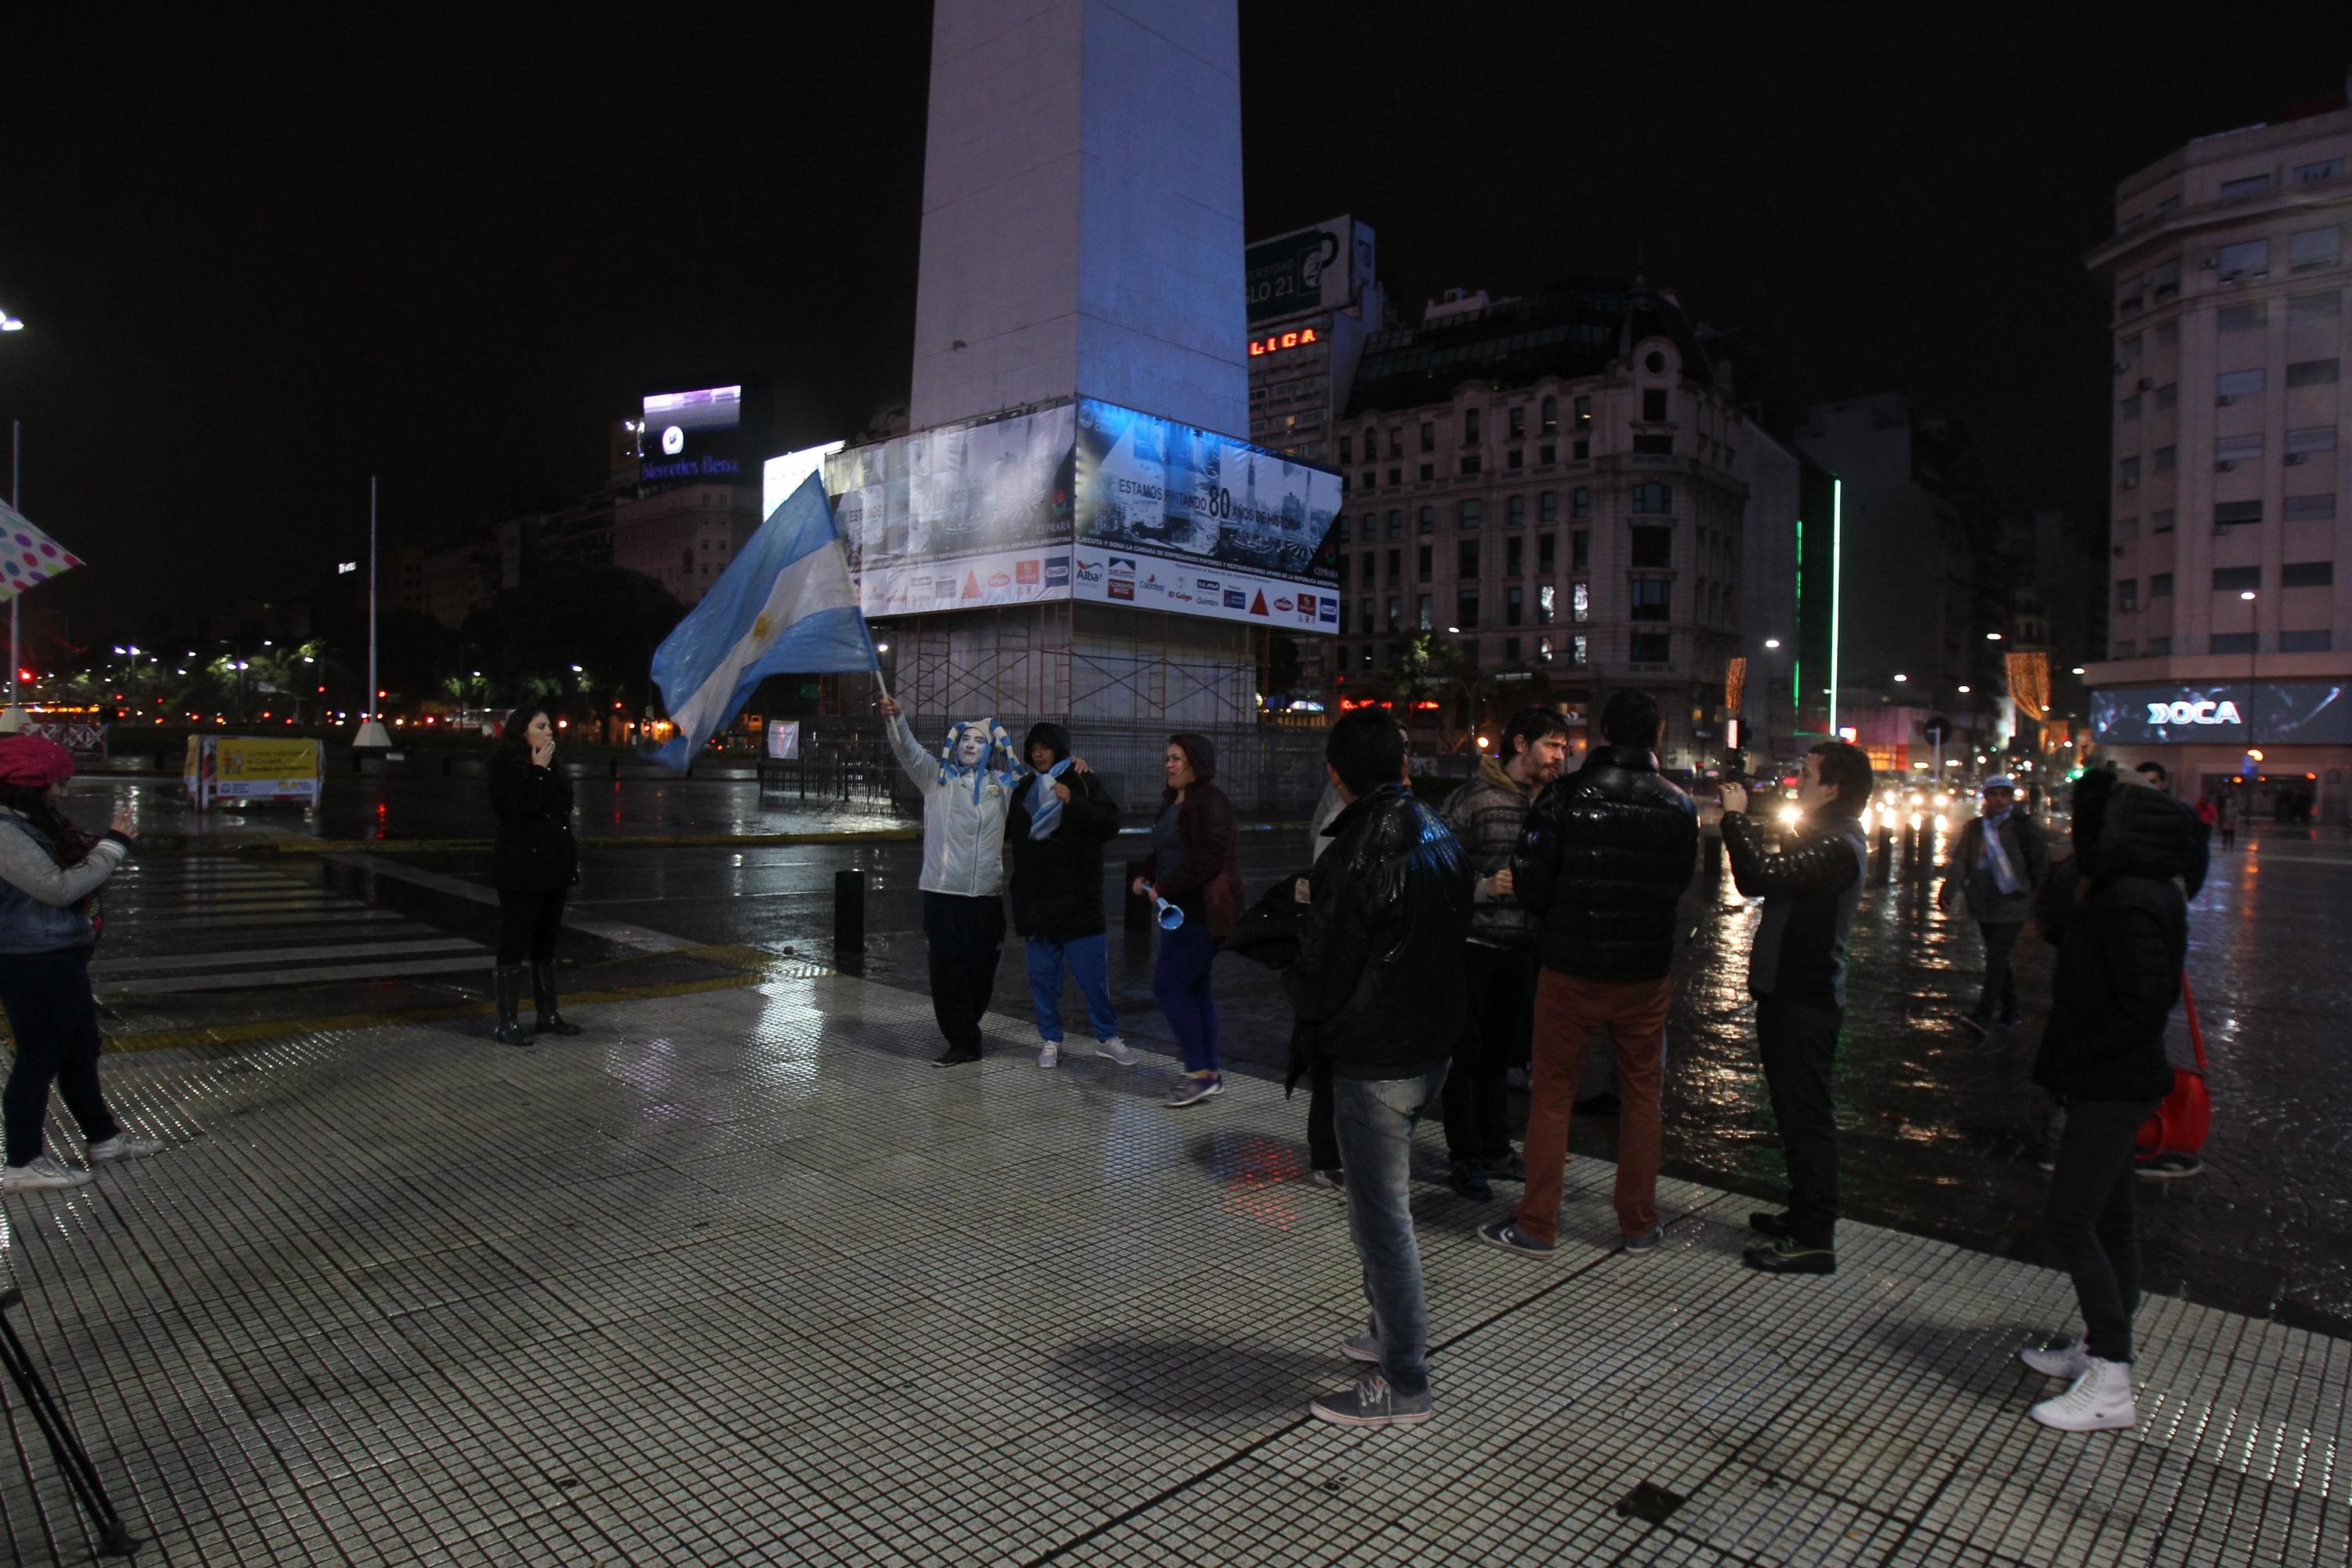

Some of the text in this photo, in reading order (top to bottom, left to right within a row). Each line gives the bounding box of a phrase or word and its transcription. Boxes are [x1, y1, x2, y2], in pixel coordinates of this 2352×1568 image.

[1276, 275, 1295, 296] 21
[702, 455, 739, 474] Benz
[1120, 479, 1163, 500] ESTAMOS
[1209, 485, 1231, 519] 80
[1255, 510, 1267, 524] DE
[1036, 521, 1072, 535] CEPRARA
[1076, 569, 1099, 582] Alba
